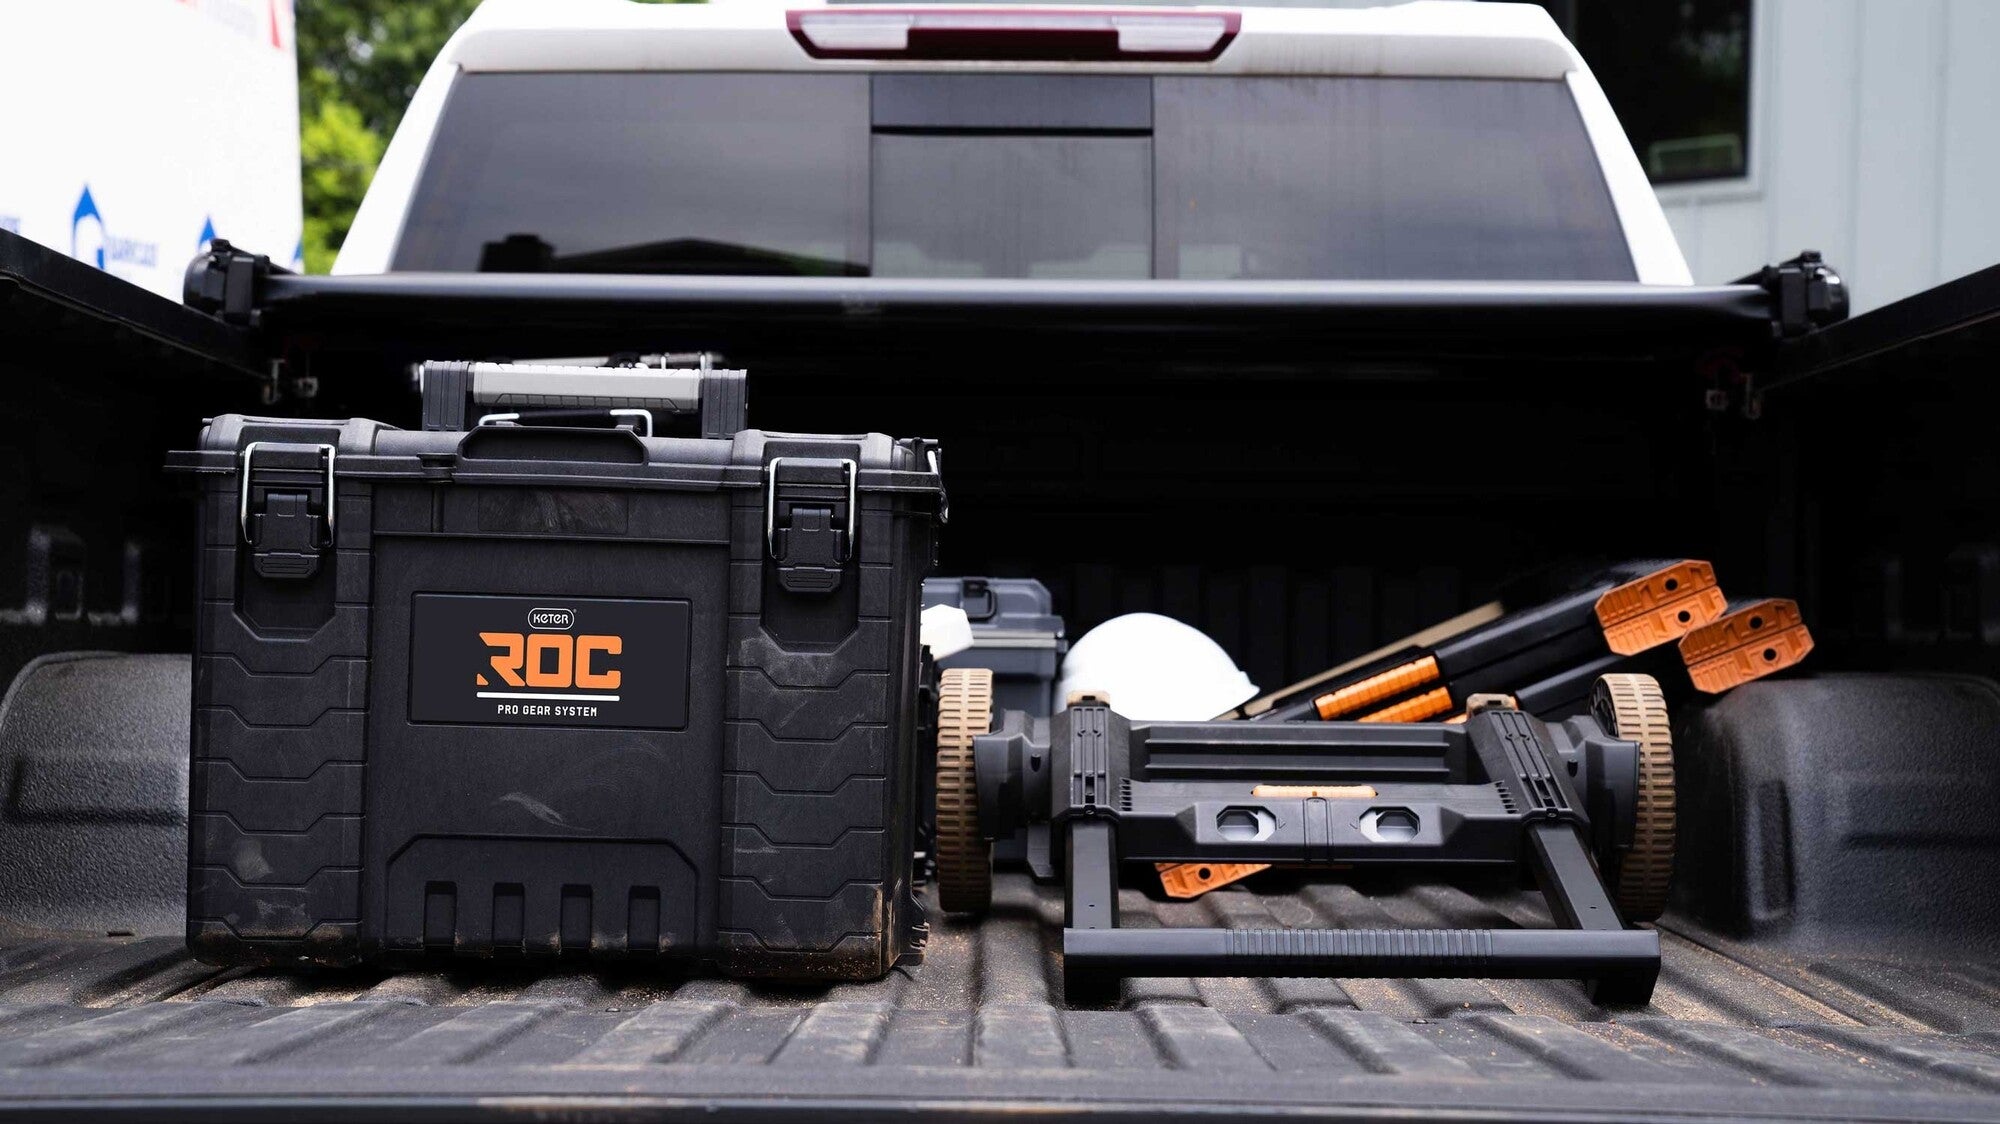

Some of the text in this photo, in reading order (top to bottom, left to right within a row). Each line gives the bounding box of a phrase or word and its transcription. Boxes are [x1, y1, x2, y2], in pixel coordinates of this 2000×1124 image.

[476, 632, 623, 690] ROC
[497, 704, 598, 717] PRO GEAR SYSTEM
